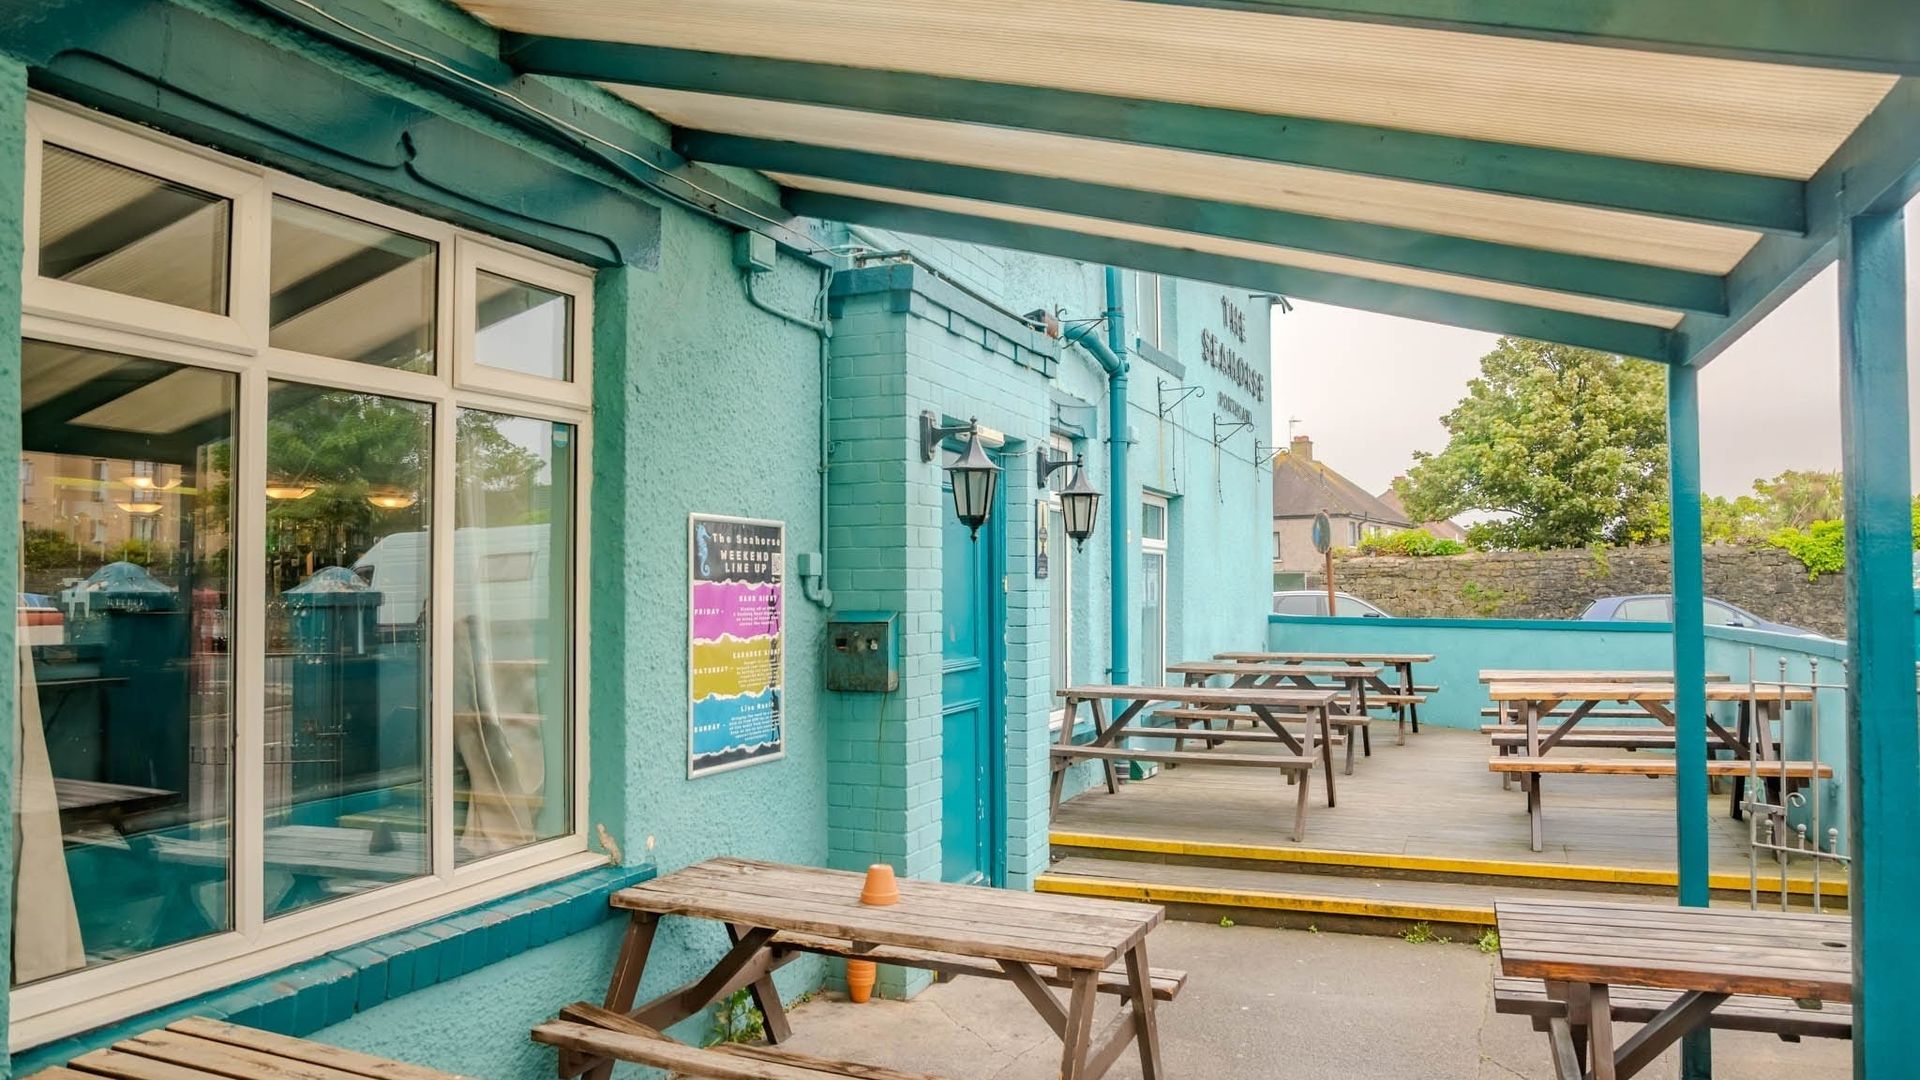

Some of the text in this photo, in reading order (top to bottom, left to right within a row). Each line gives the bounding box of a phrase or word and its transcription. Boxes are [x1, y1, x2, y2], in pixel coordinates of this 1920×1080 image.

[1221, 295, 1246, 343] THE
[1201, 328, 1264, 402] SEAHORSE
[713, 534, 781, 546] The Seahorse
[720, 550, 769, 561] WEEKEND
[725, 563, 767, 573] LINE UP
